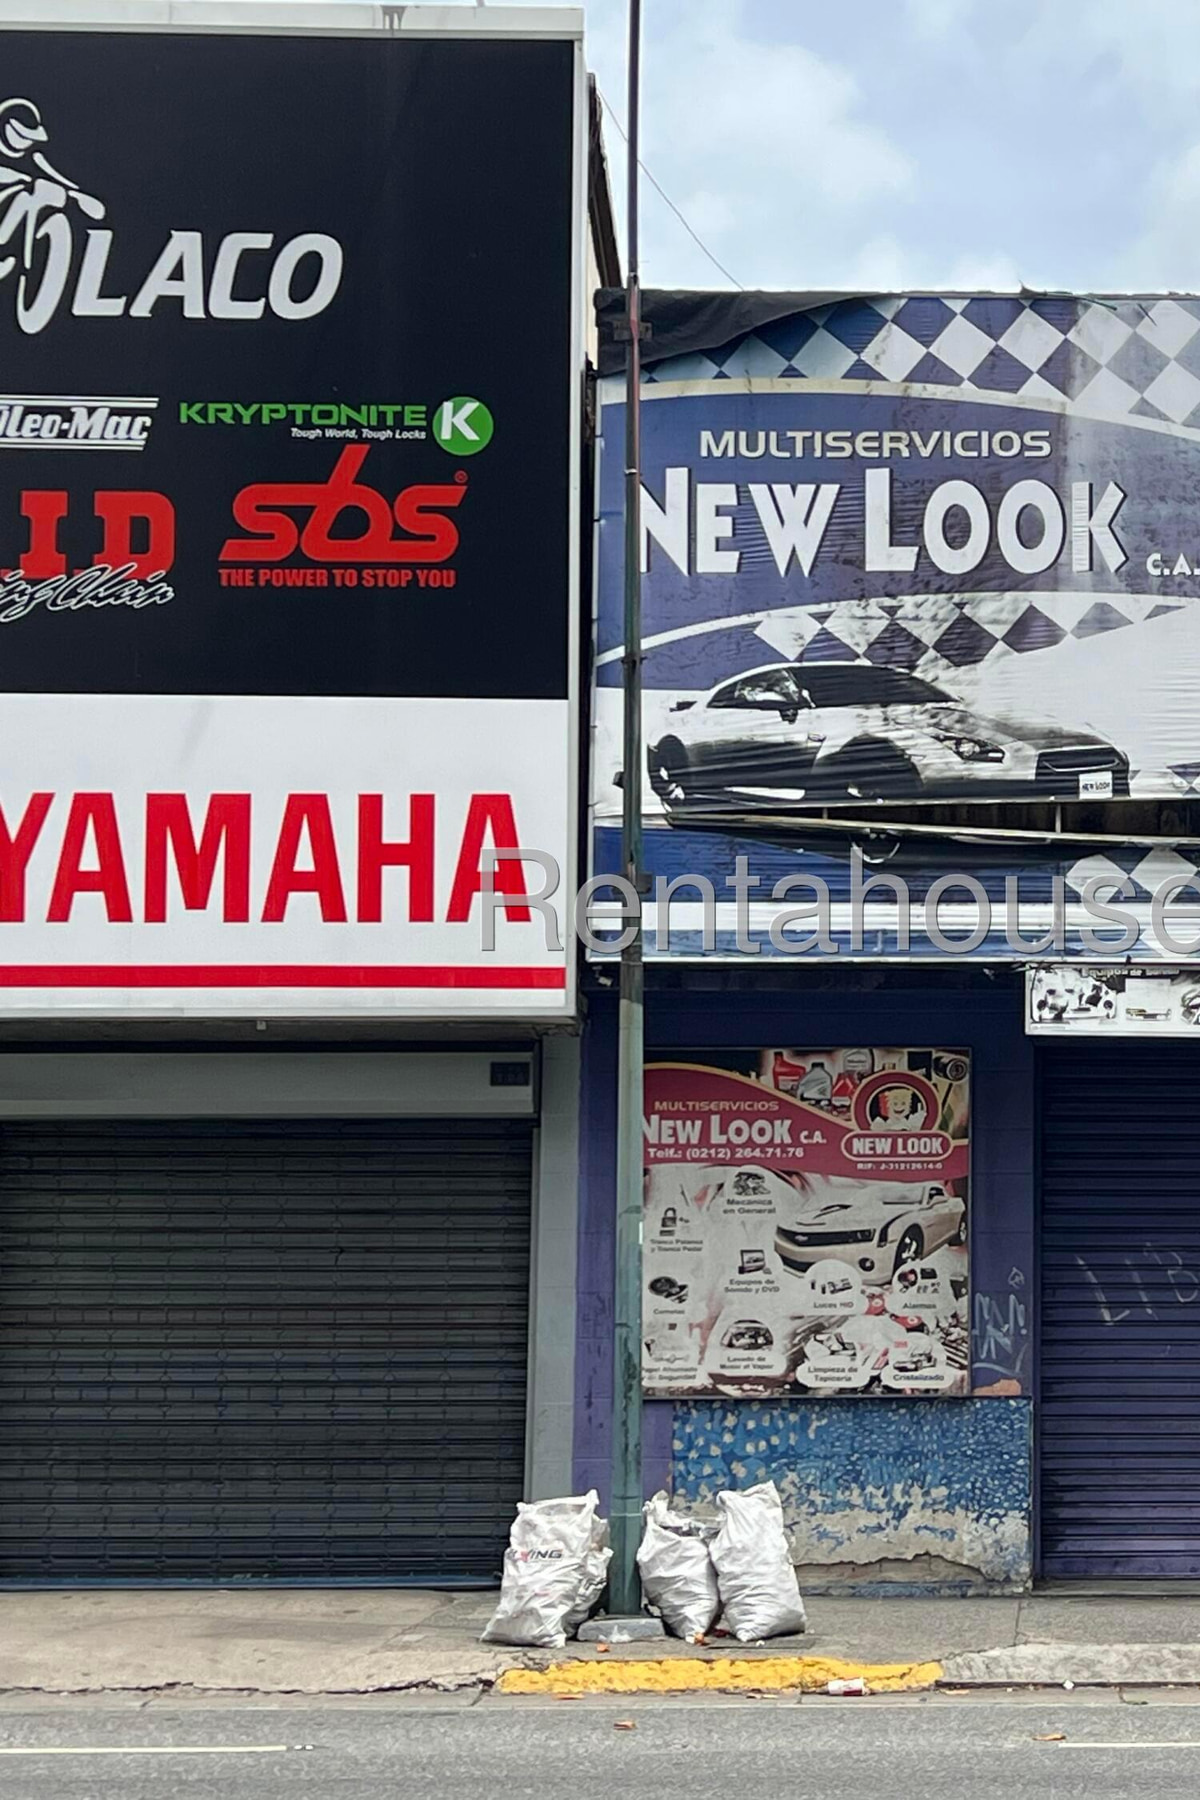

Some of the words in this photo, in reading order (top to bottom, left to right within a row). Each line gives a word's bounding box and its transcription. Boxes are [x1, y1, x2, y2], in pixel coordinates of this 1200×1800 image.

[179, 402, 428, 427] KRYPTONITE
[290, 427, 323, 439] Tough
[325, 428, 359, 440] World,
[361, 428, 393, 440] Tough
[395, 428, 427, 440] Locks
[700, 430, 1052, 458] MULTISERVICIOS
[639, 467, 841, 578] NEW
[864, 467, 1129, 576] LOOK
[218, 568, 255, 586] THE
[258, 568, 329, 587] POWER
[332, 568, 357, 587] TO
[361, 568, 413, 587] STOP
[415, 568, 456, 587] YOU
[0, 791, 532, 923] YAMAHA
[654, 1101, 780, 1112] MULTISERVICIOS
[643, 1114, 703, 1145] NEW
[710, 1114, 793, 1145] LOOK
[799, 1130, 828, 1144] C.A.
[686, 1148, 731, 1160] (0212)
[852, 1137, 893, 1155] NEW
[897, 1137, 944, 1155] LOOK
